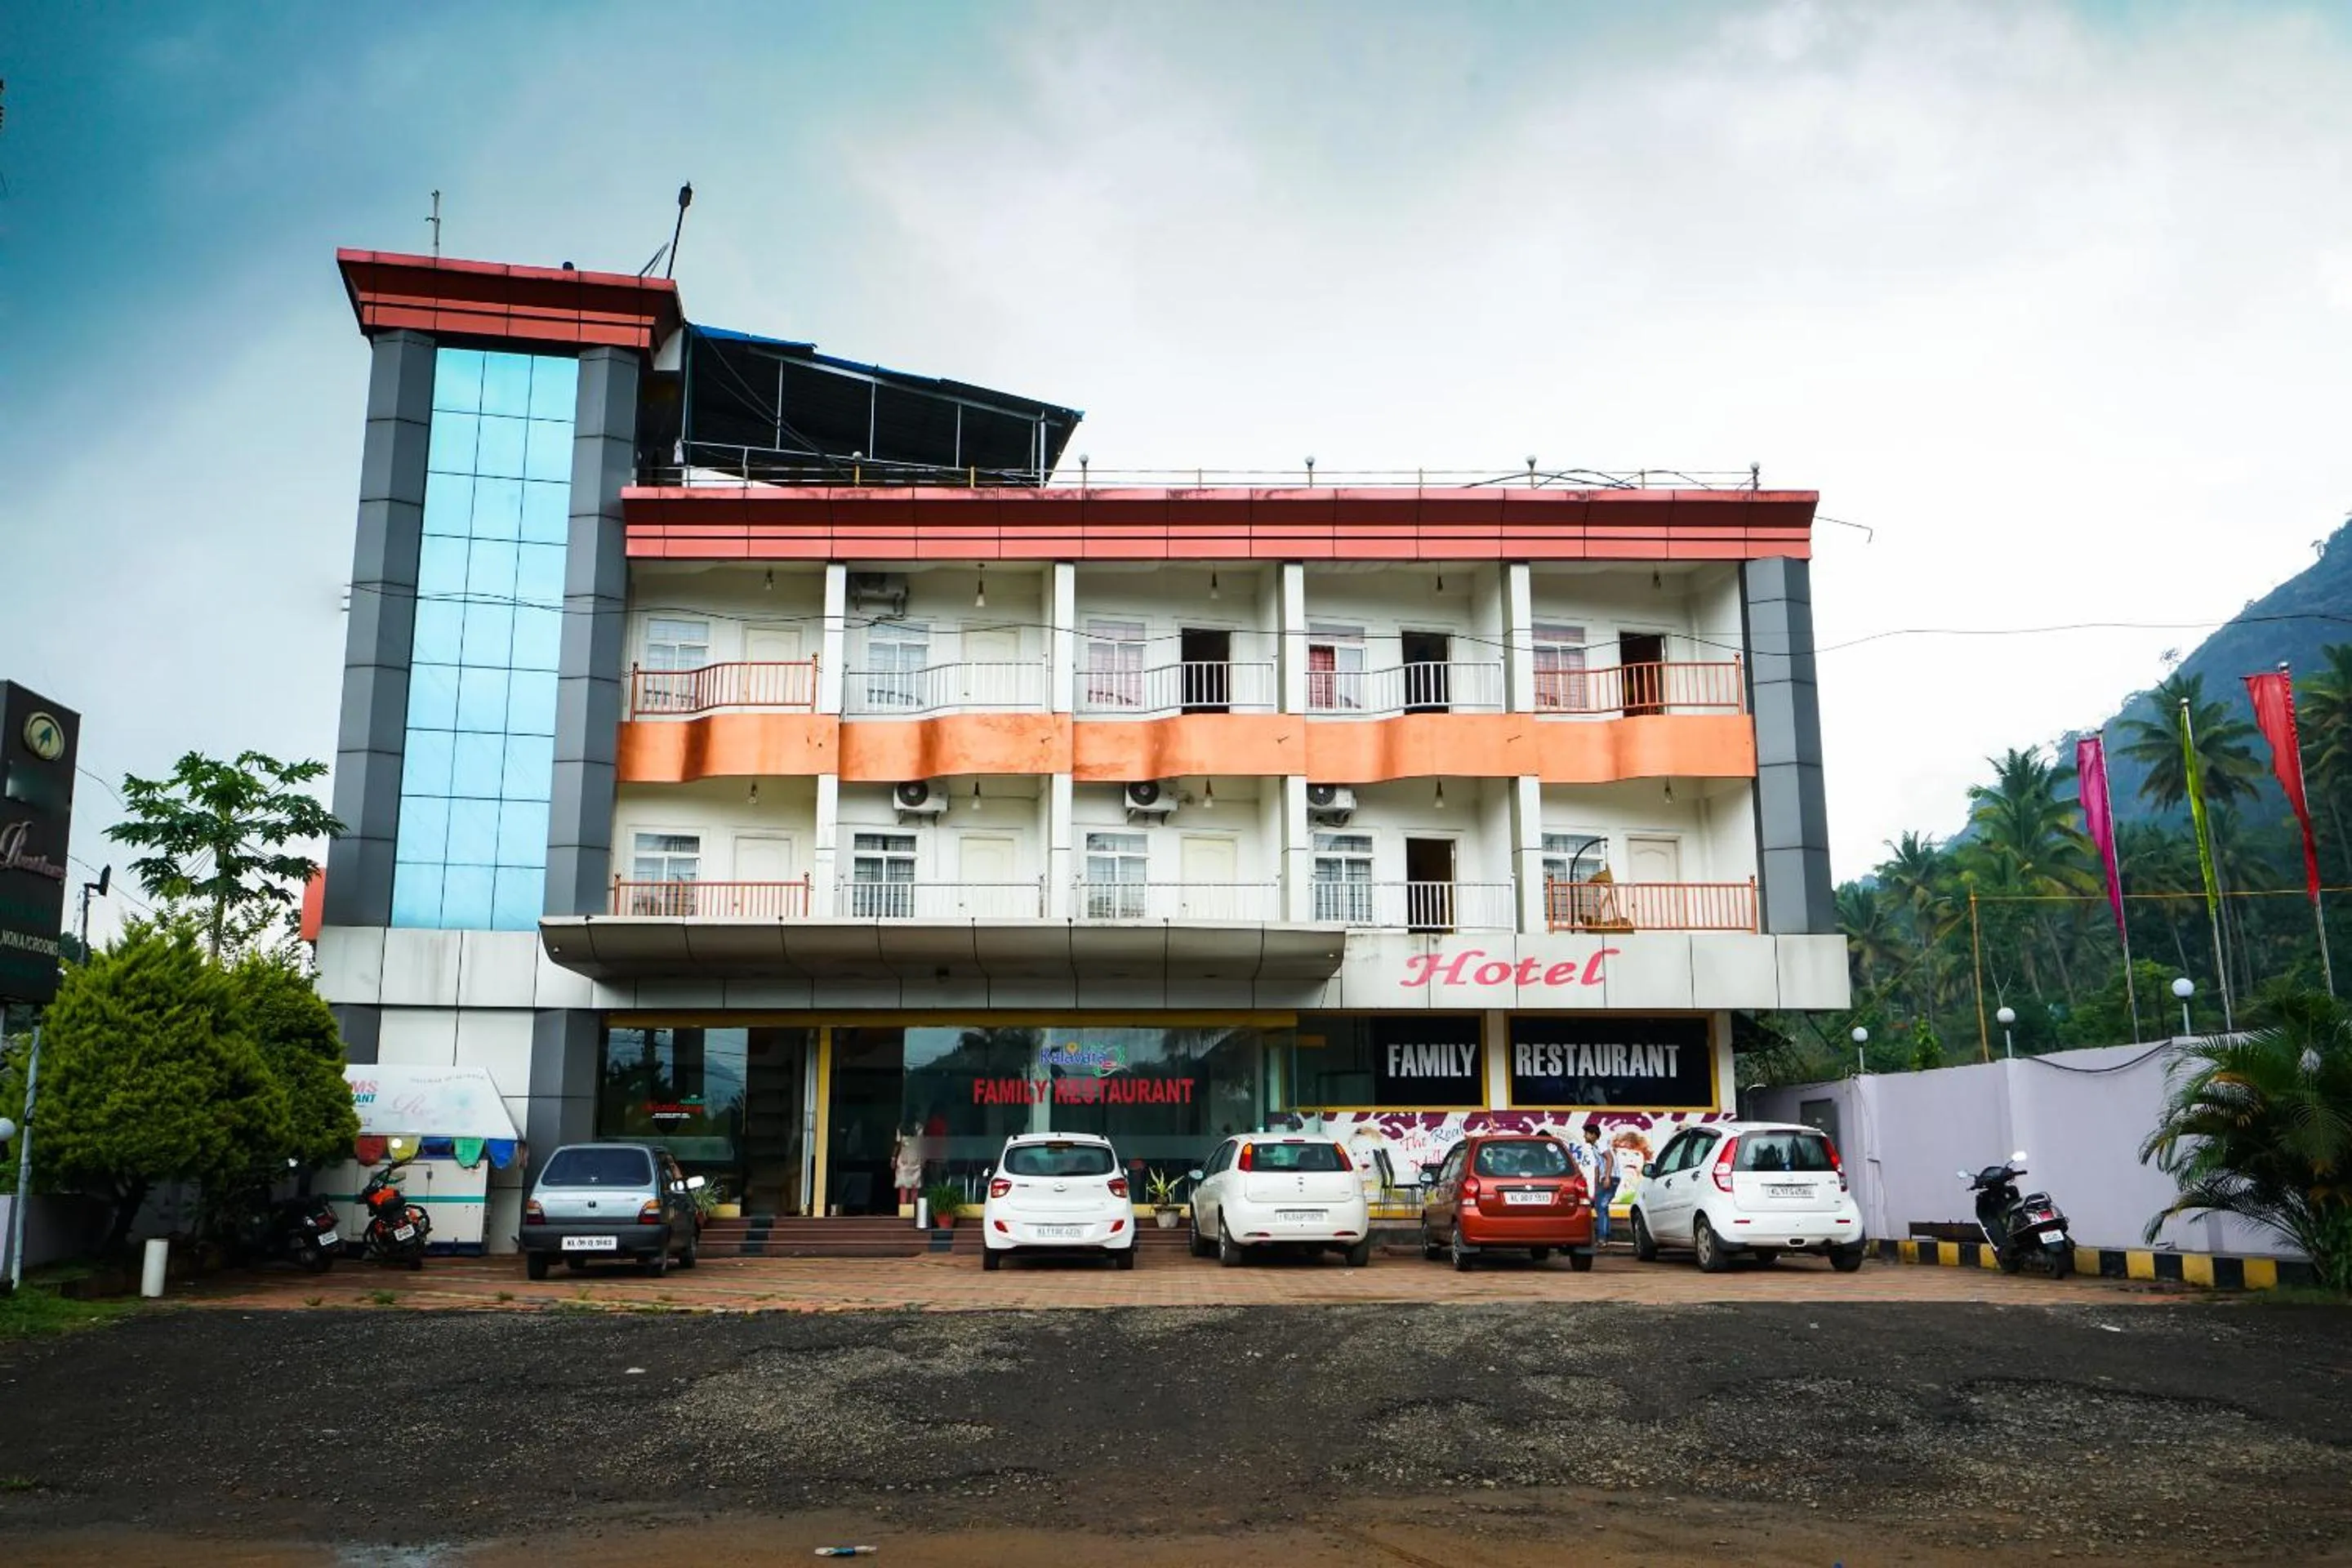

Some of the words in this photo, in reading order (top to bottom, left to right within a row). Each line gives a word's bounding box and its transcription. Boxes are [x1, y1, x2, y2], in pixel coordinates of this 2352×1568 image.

[1399, 948, 1620, 988] Hotel
[1388, 1044, 1477, 1078] FAMILY
[1515, 1043, 1681, 1078] RESTAURANT
[973, 1078, 1048, 1104] FAMILY
[1054, 1078, 1195, 1104] RESTAURANT
[1430, 1117, 1463, 1143] Real
